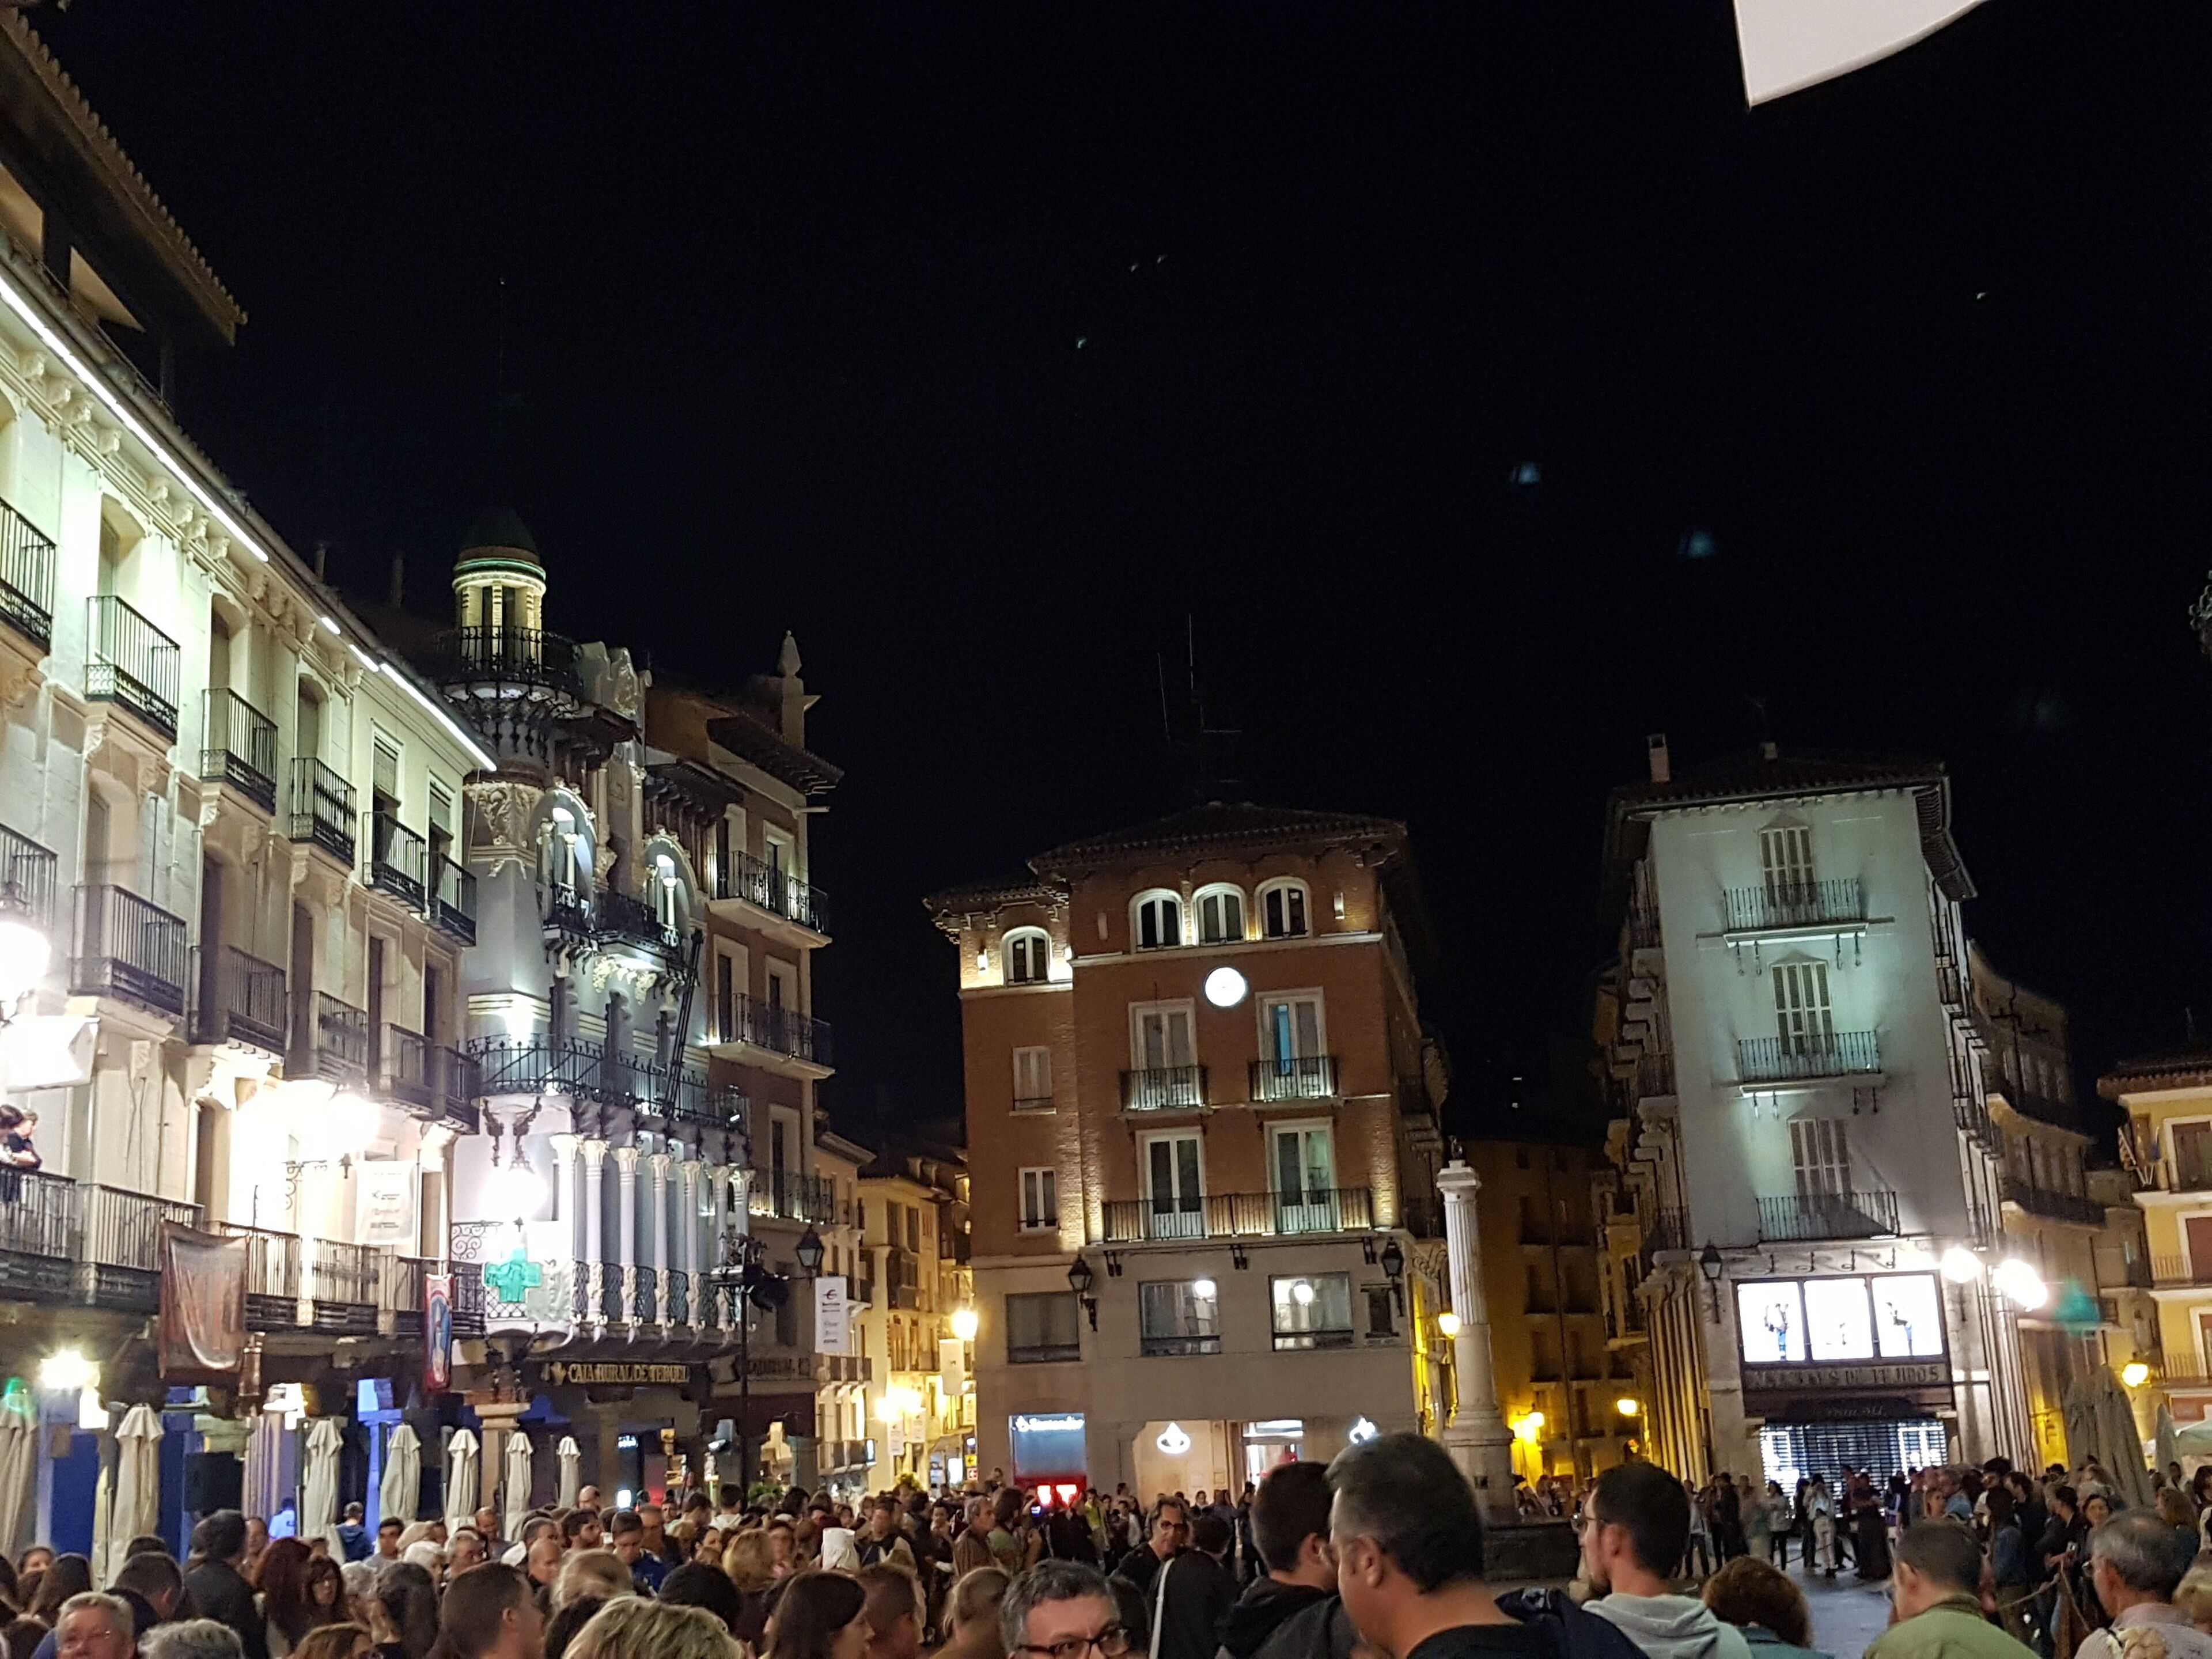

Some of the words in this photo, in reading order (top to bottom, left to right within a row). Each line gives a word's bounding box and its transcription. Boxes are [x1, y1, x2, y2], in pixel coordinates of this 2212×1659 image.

[596, 1363, 632, 1382] RURAL
[634, 1365, 649, 1382] DE
[650, 1365, 690, 1382] TERUEL
